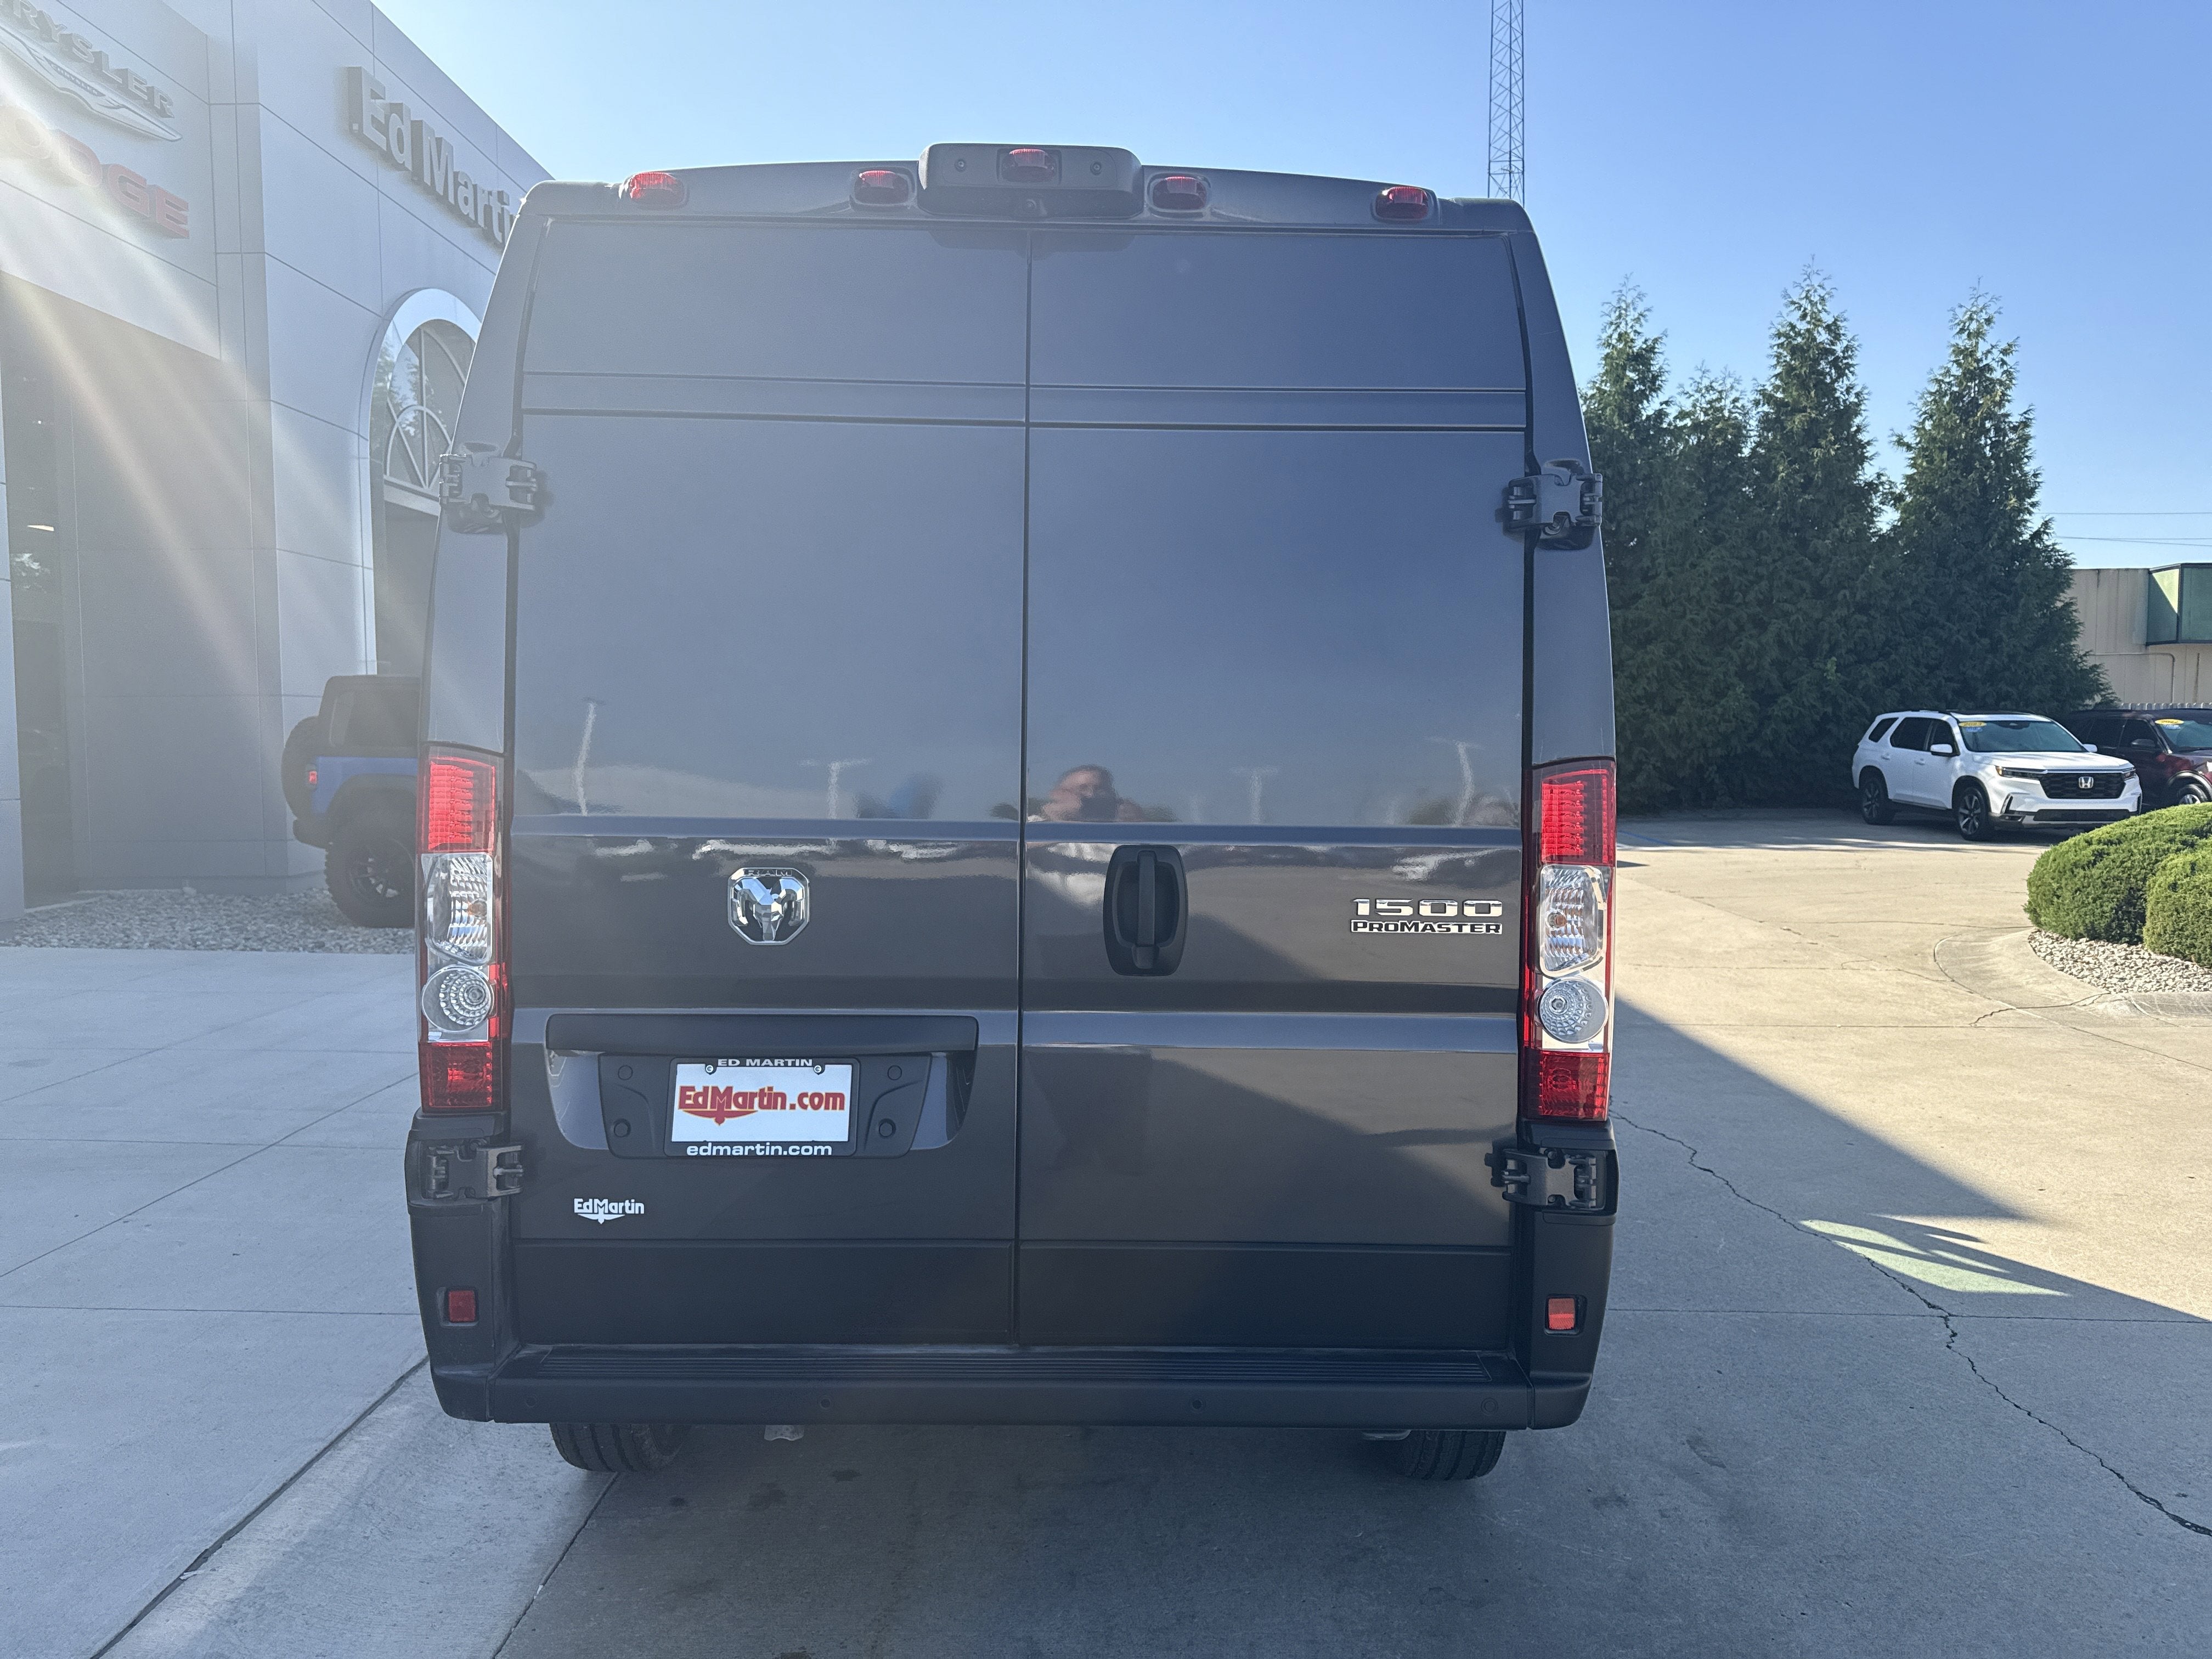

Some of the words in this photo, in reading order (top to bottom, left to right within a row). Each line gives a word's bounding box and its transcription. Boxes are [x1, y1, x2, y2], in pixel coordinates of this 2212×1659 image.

[0, 0, 174, 119] RYSLER
[351, 66, 411, 172] Ed
[420, 120, 516, 245] Marti
[744, 868, 793, 877] RAM
[1352, 899, 1503, 917] 1500
[1351, 919, 1502, 934] PROMASTER
[678, 1085, 845, 1111] EdMartin.com
[687, 1142, 832, 1156] edmartin.com
[574, 1198, 645, 1215] EdMartin
